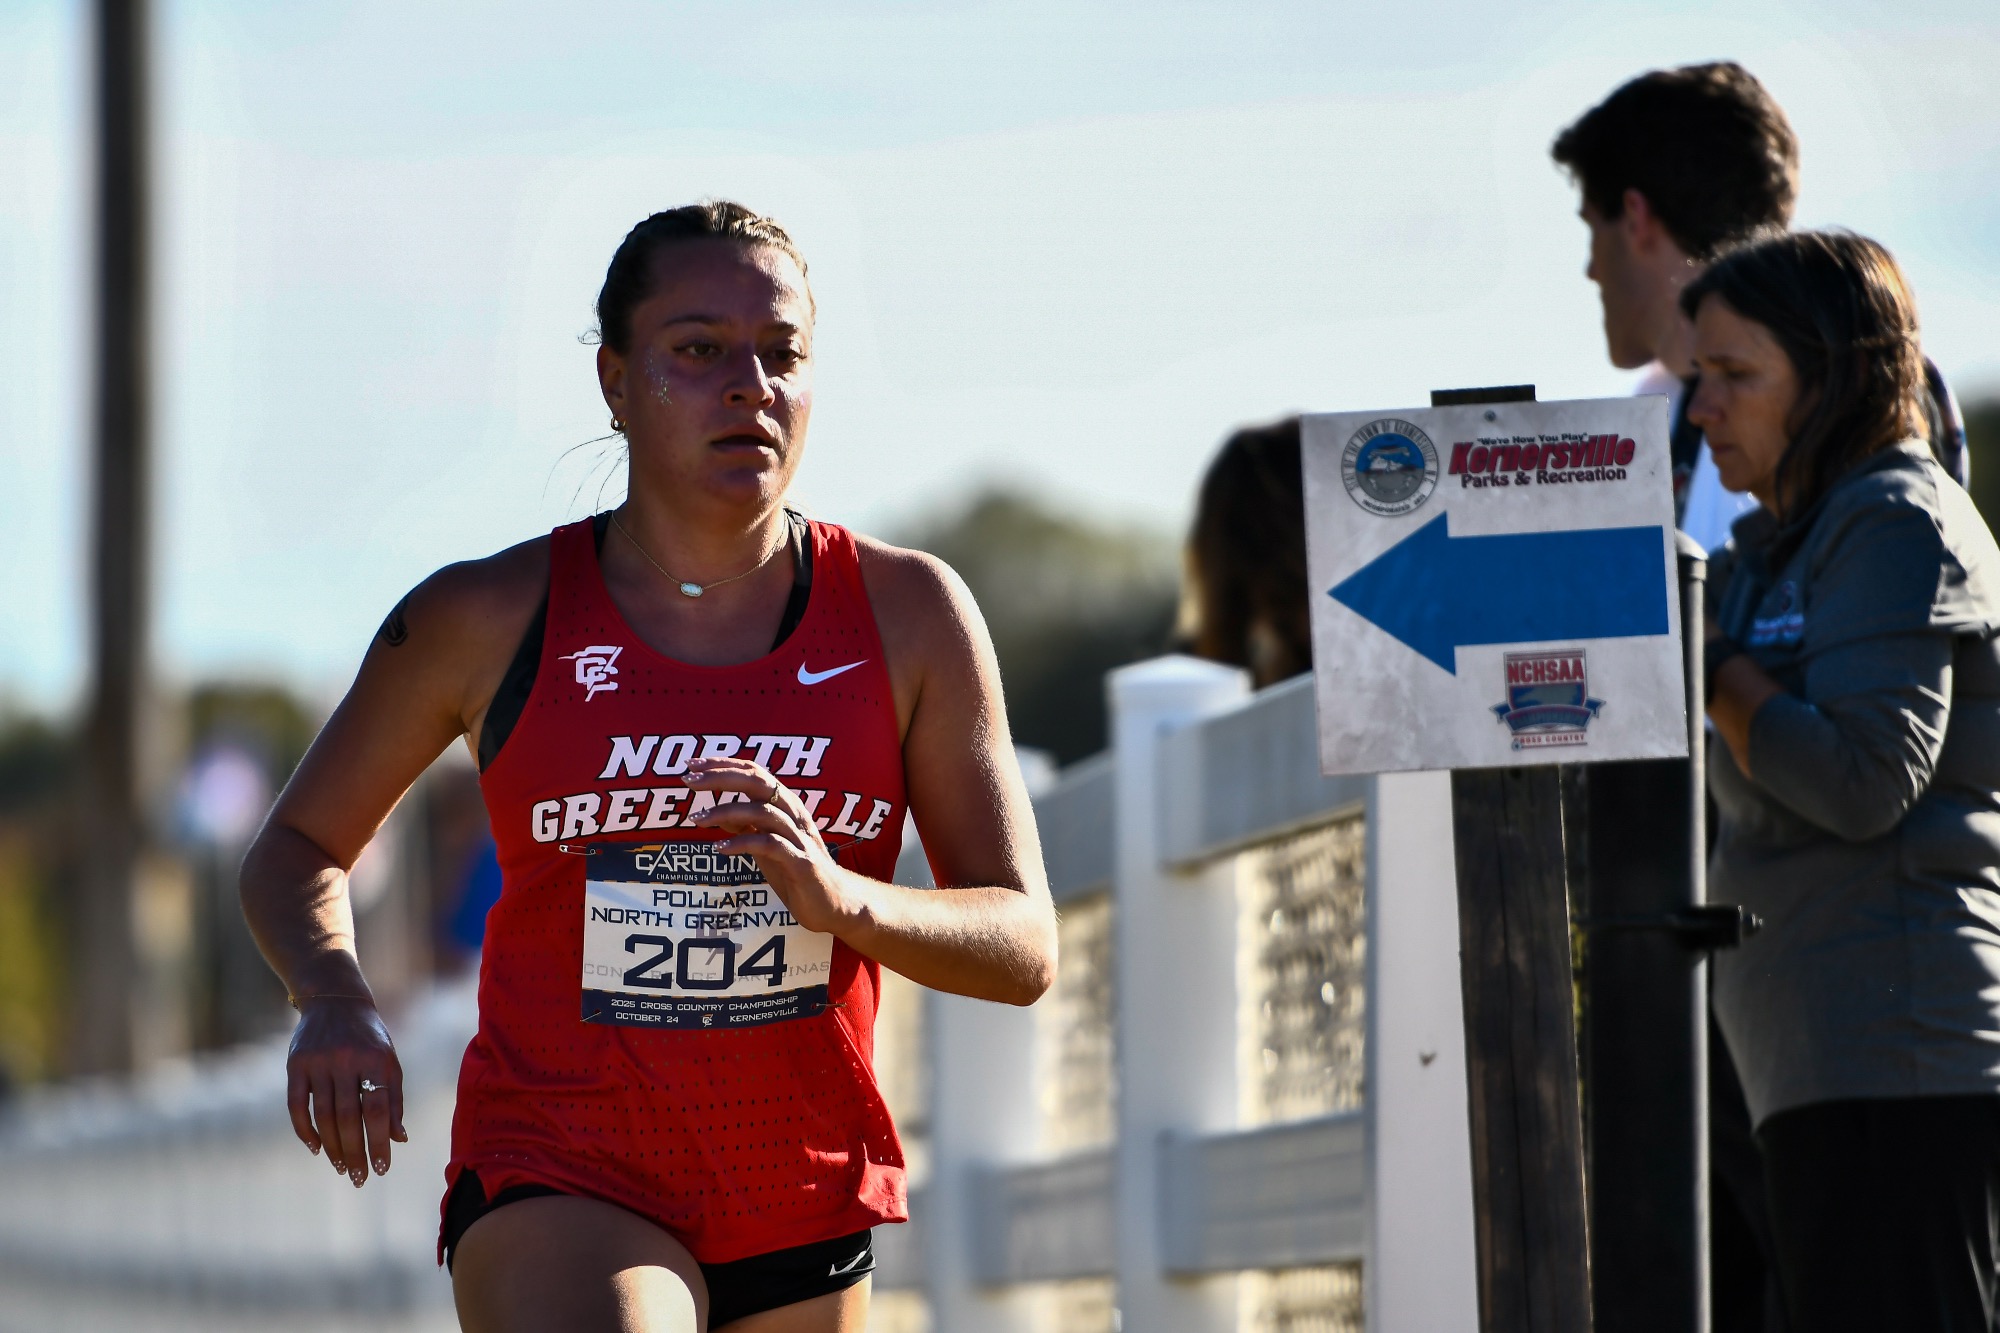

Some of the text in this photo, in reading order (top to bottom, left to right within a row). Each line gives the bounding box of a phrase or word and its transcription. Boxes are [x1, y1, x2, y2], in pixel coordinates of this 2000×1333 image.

[1538, 434, 1558, 442] You
[1448, 434, 1636, 474] Kernersville
[1461, 466, 1627, 488] Parks & Recreation
[1506, 658, 1584, 683] NCHSAA
[598, 734, 831, 779] NORTH
[532, 787, 892, 843] GREELLE
[668, 844, 720, 854] CONFE
[635, 849, 760, 875] CAROLIN
[656, 873, 698, 881] CHAMPIONS
[701, 874, 709, 882] IN
[711, 875, 732, 883] BODY,
[734, 873, 752, 881] MIND
[652, 889, 768, 909] POLLARD
[591, 906, 799, 930] NORTH GREENVIL
[623, 933, 787, 990] 204
[611, 995, 799, 1012] 2025 CROSS COUNTRY CHAMPIONSHIP
[615, 1012, 661, 1022] OCTOBER
[666, 1015, 679, 1023] 24
[729, 1007, 799, 1023] KERNERSVILLE
